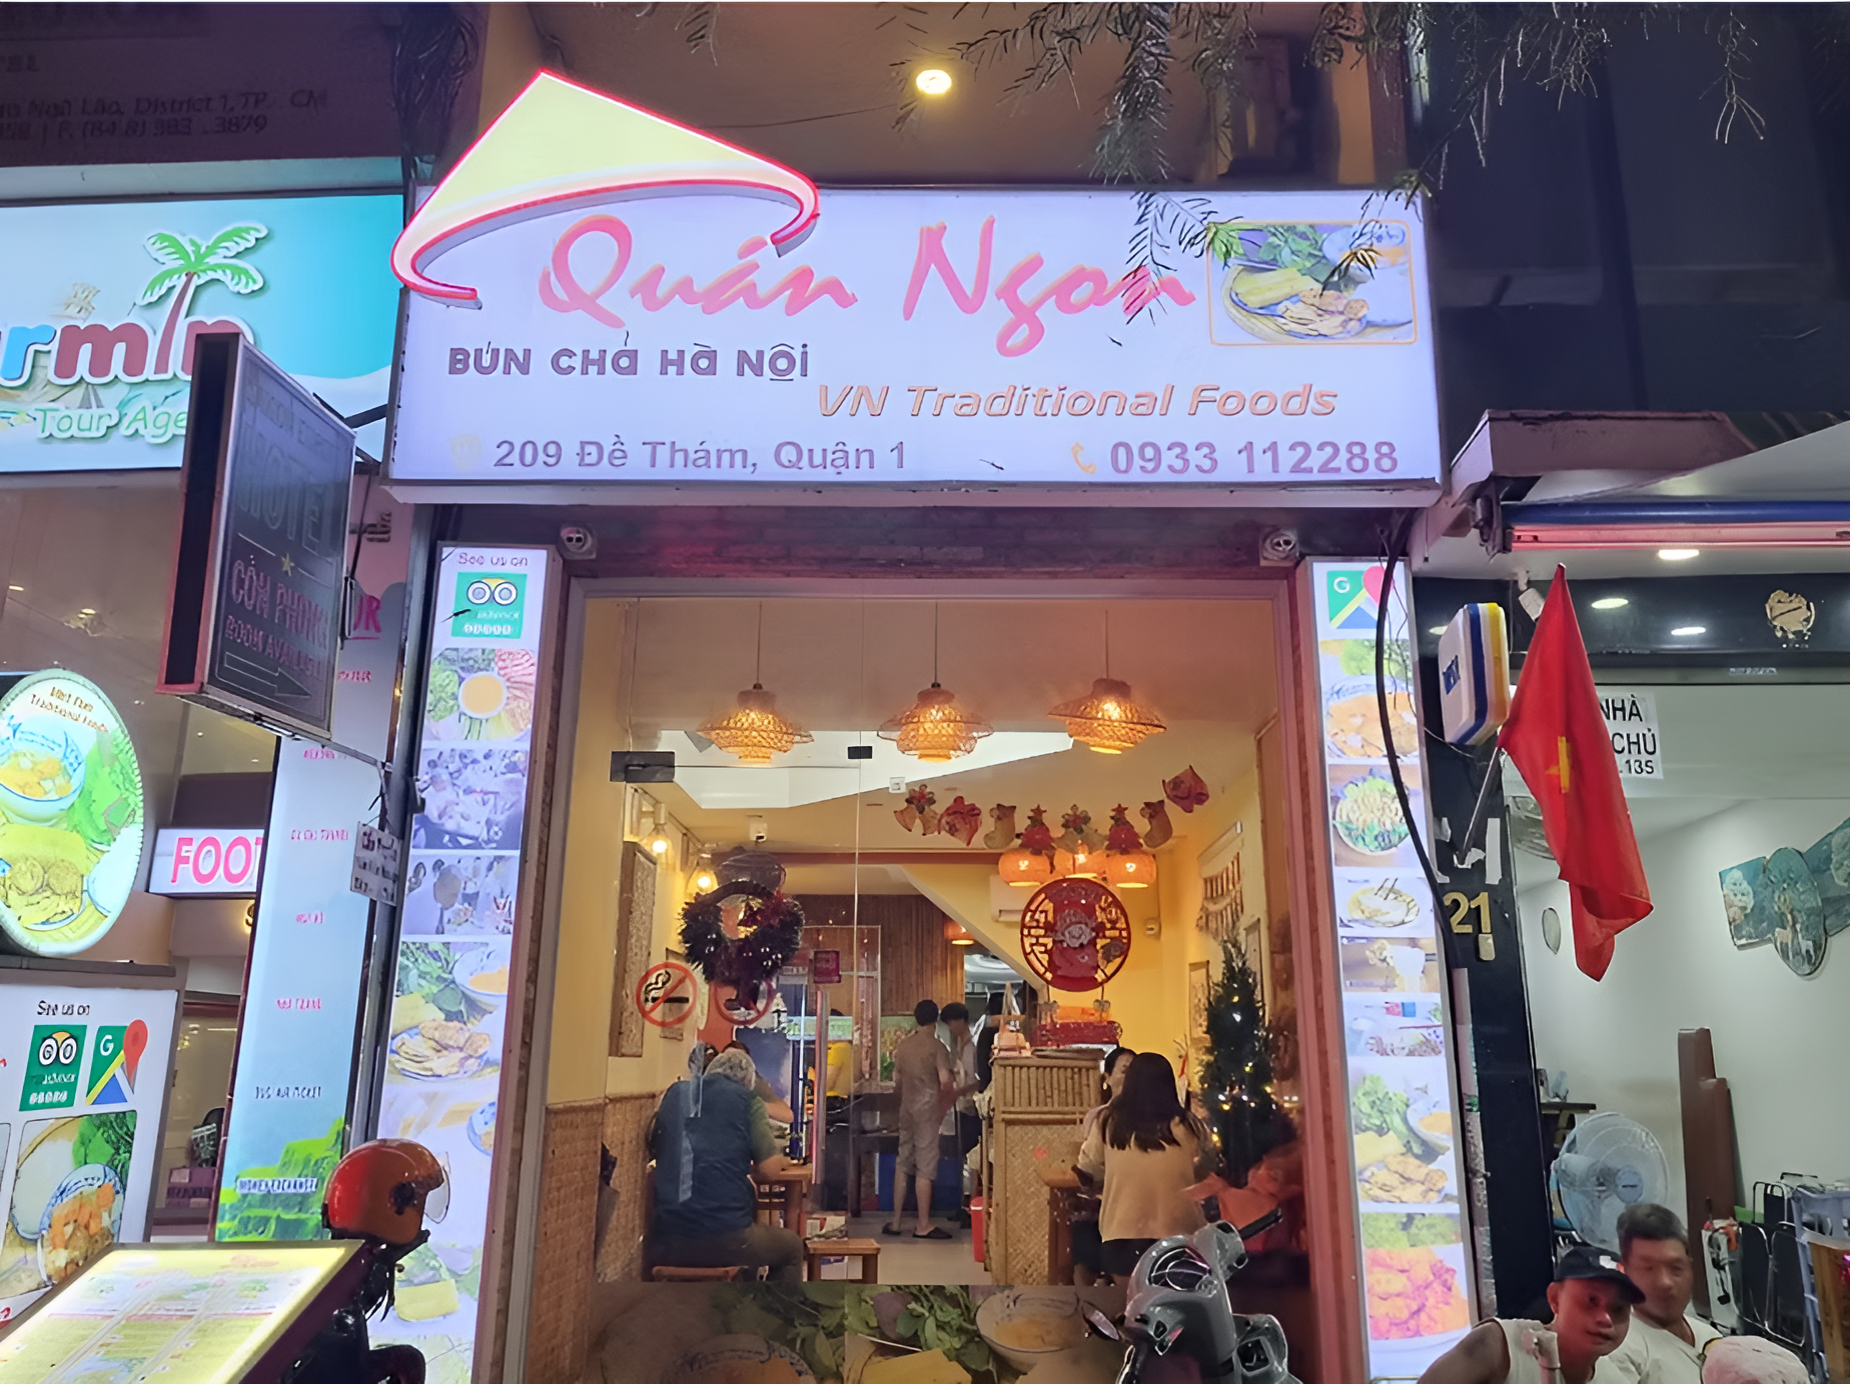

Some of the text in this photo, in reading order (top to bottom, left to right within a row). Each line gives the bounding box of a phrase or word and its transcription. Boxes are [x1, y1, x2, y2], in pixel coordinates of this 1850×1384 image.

[538, 213, 1197, 357] Quán Ngon
[448, 341, 532, 376] BÚN
[818, 383, 1339, 417] VN Traditional Foods
[34, 408, 112, 434] Tour
[493, 434, 906, 475] 209 Đề Thám, Quận 1
[1110, 440, 1398, 475] 0933 112288
[458, 552, 485, 566] See
[171, 836, 264, 884] FOO
